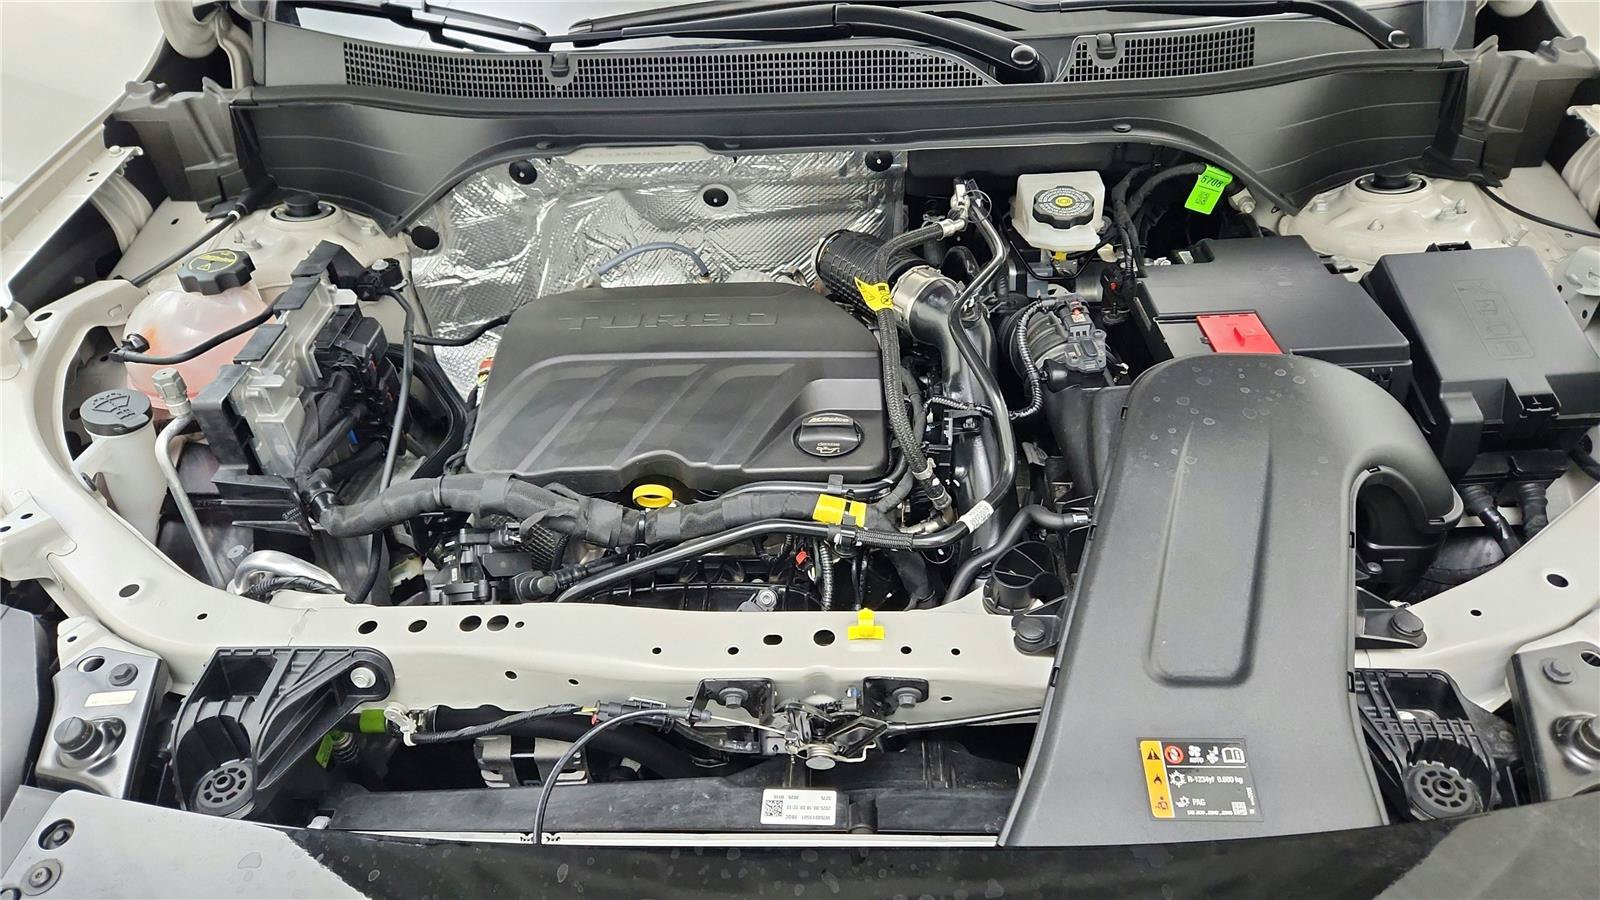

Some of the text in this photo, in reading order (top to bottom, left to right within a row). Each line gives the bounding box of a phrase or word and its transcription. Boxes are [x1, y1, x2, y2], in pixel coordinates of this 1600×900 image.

[558, 312, 778, 330] TURBO
[1234, 775, 1244, 785] kg
[1192, 798, 1206, 806] PAG
